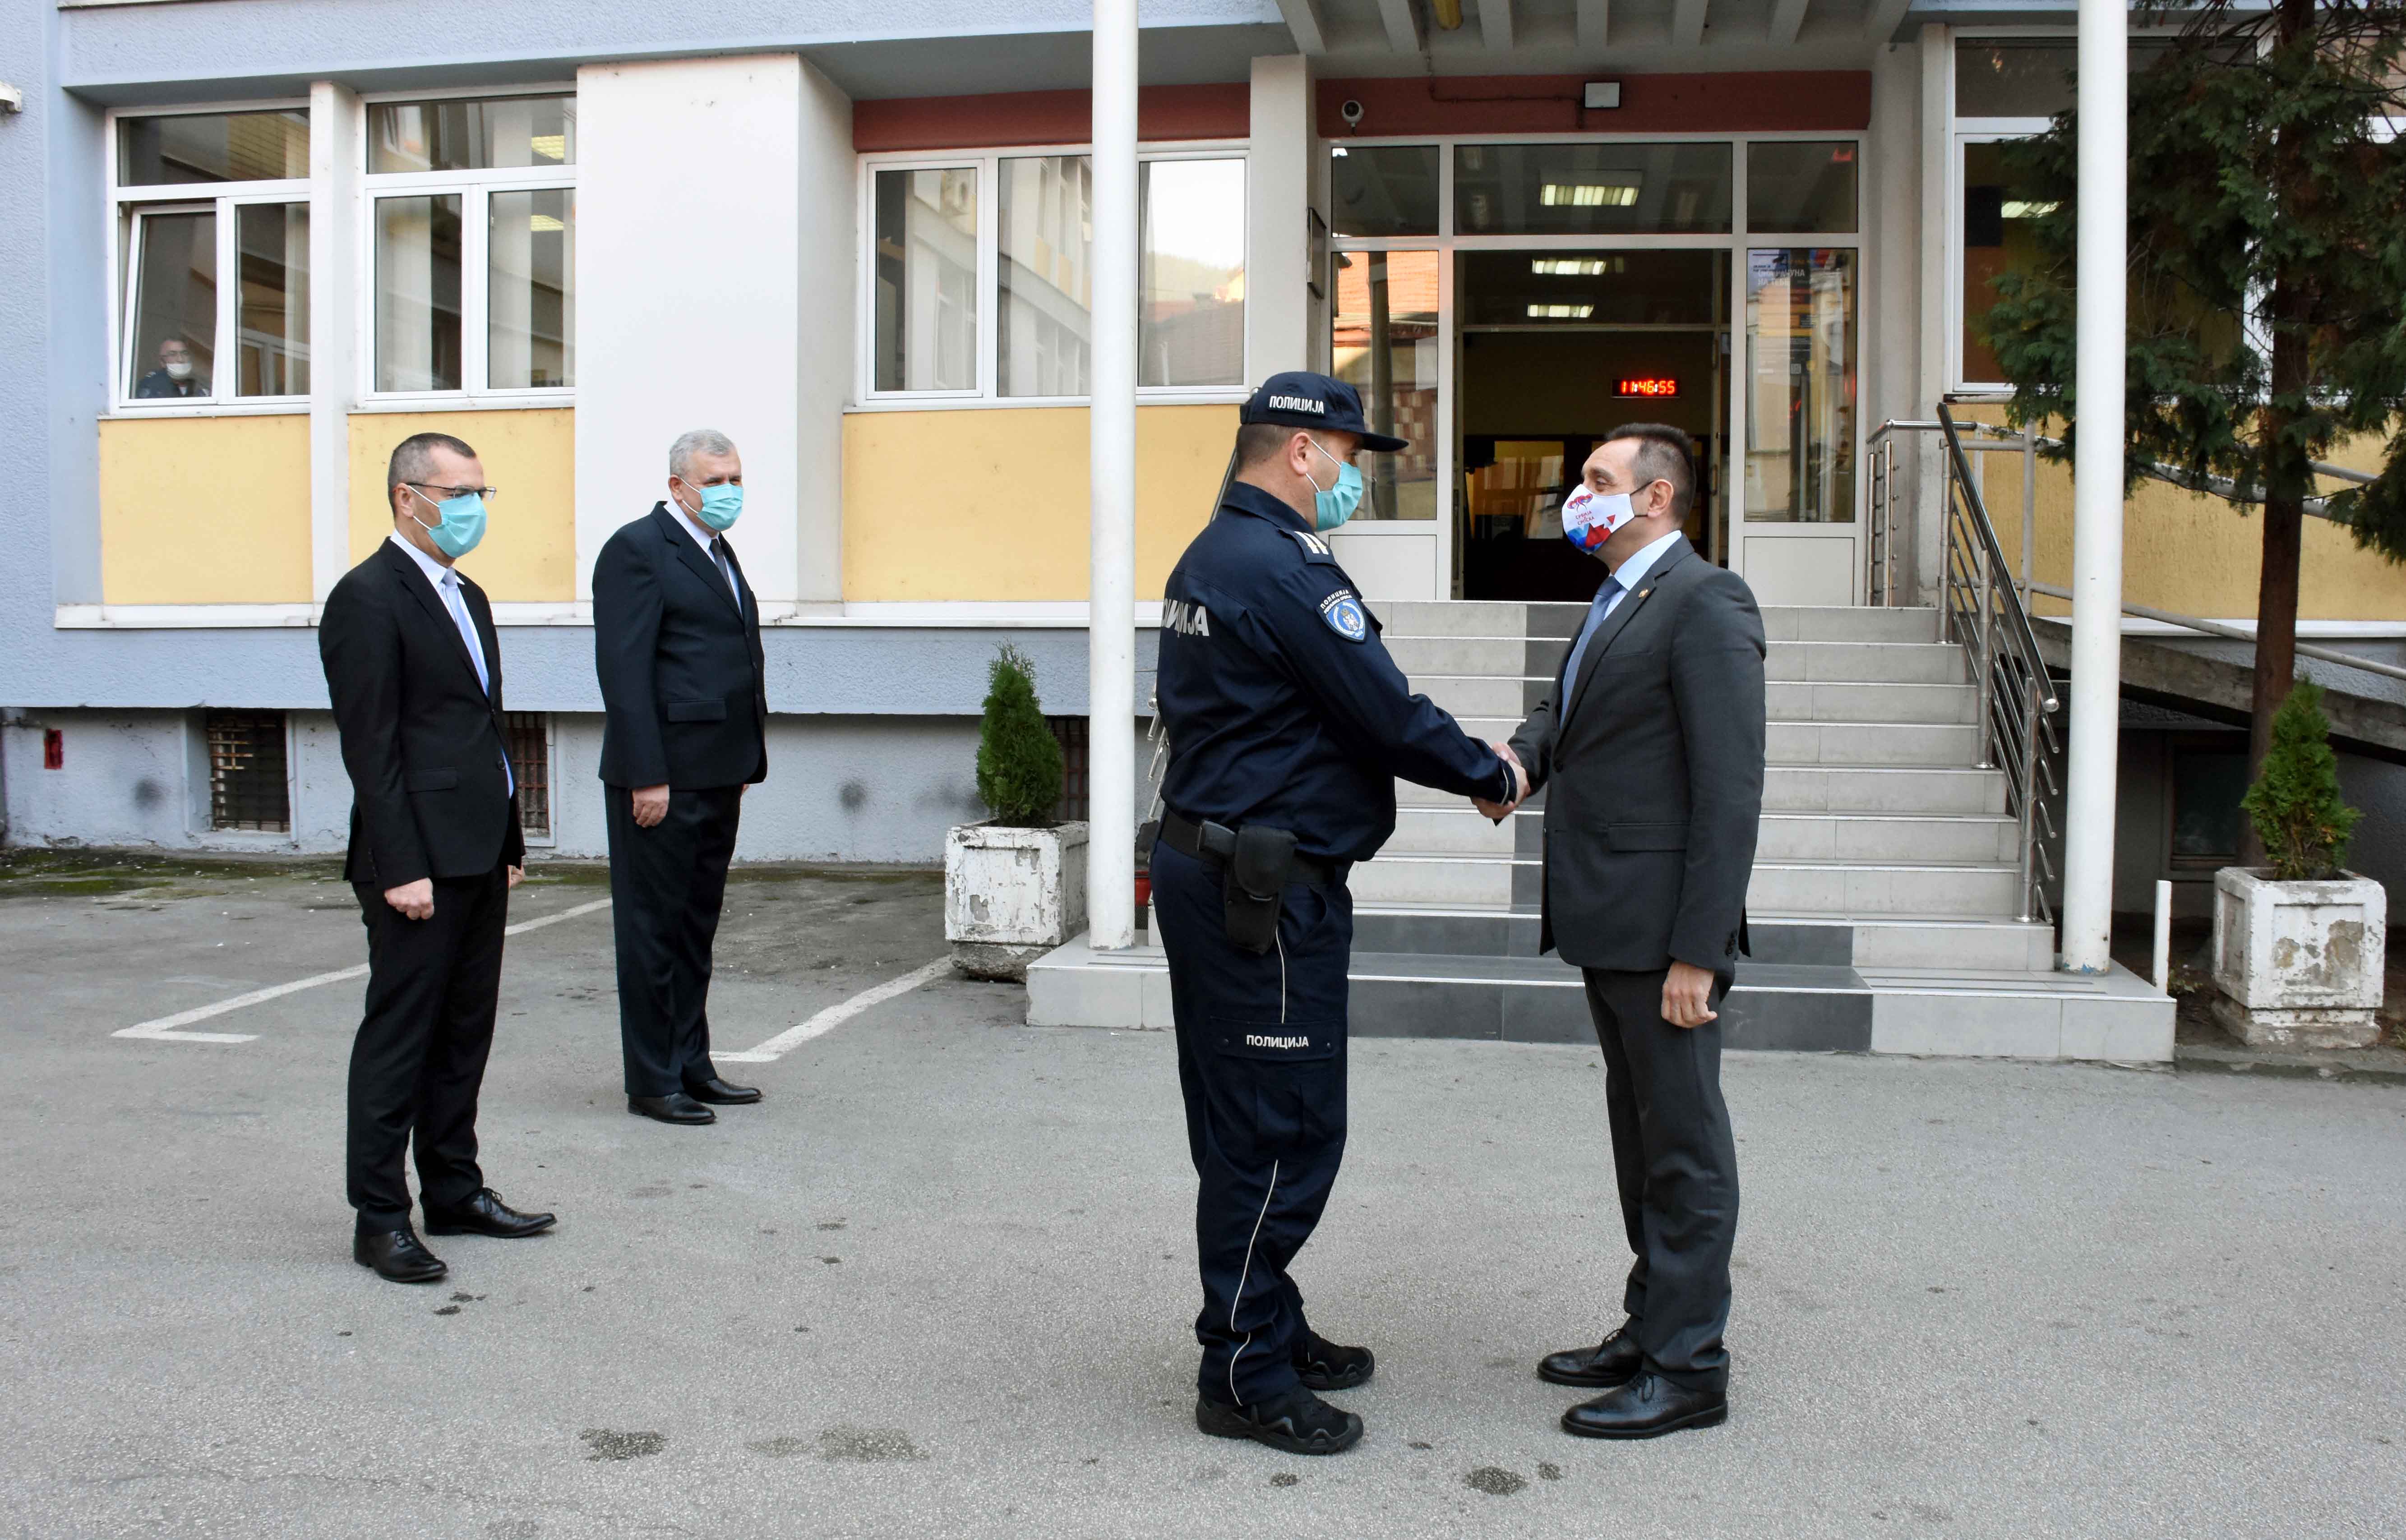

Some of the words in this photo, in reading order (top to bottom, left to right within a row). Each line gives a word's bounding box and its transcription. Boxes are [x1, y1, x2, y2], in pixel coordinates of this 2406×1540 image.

[1621, 379, 1675, 394] 11:46:55
[1269, 396, 1325, 414] ПОЛИЦИЈА
[1320, 589, 1349, 609] ПОЛИЦИЈА
[1247, 1034, 1309, 1050] ПОЛИЦИЈА
